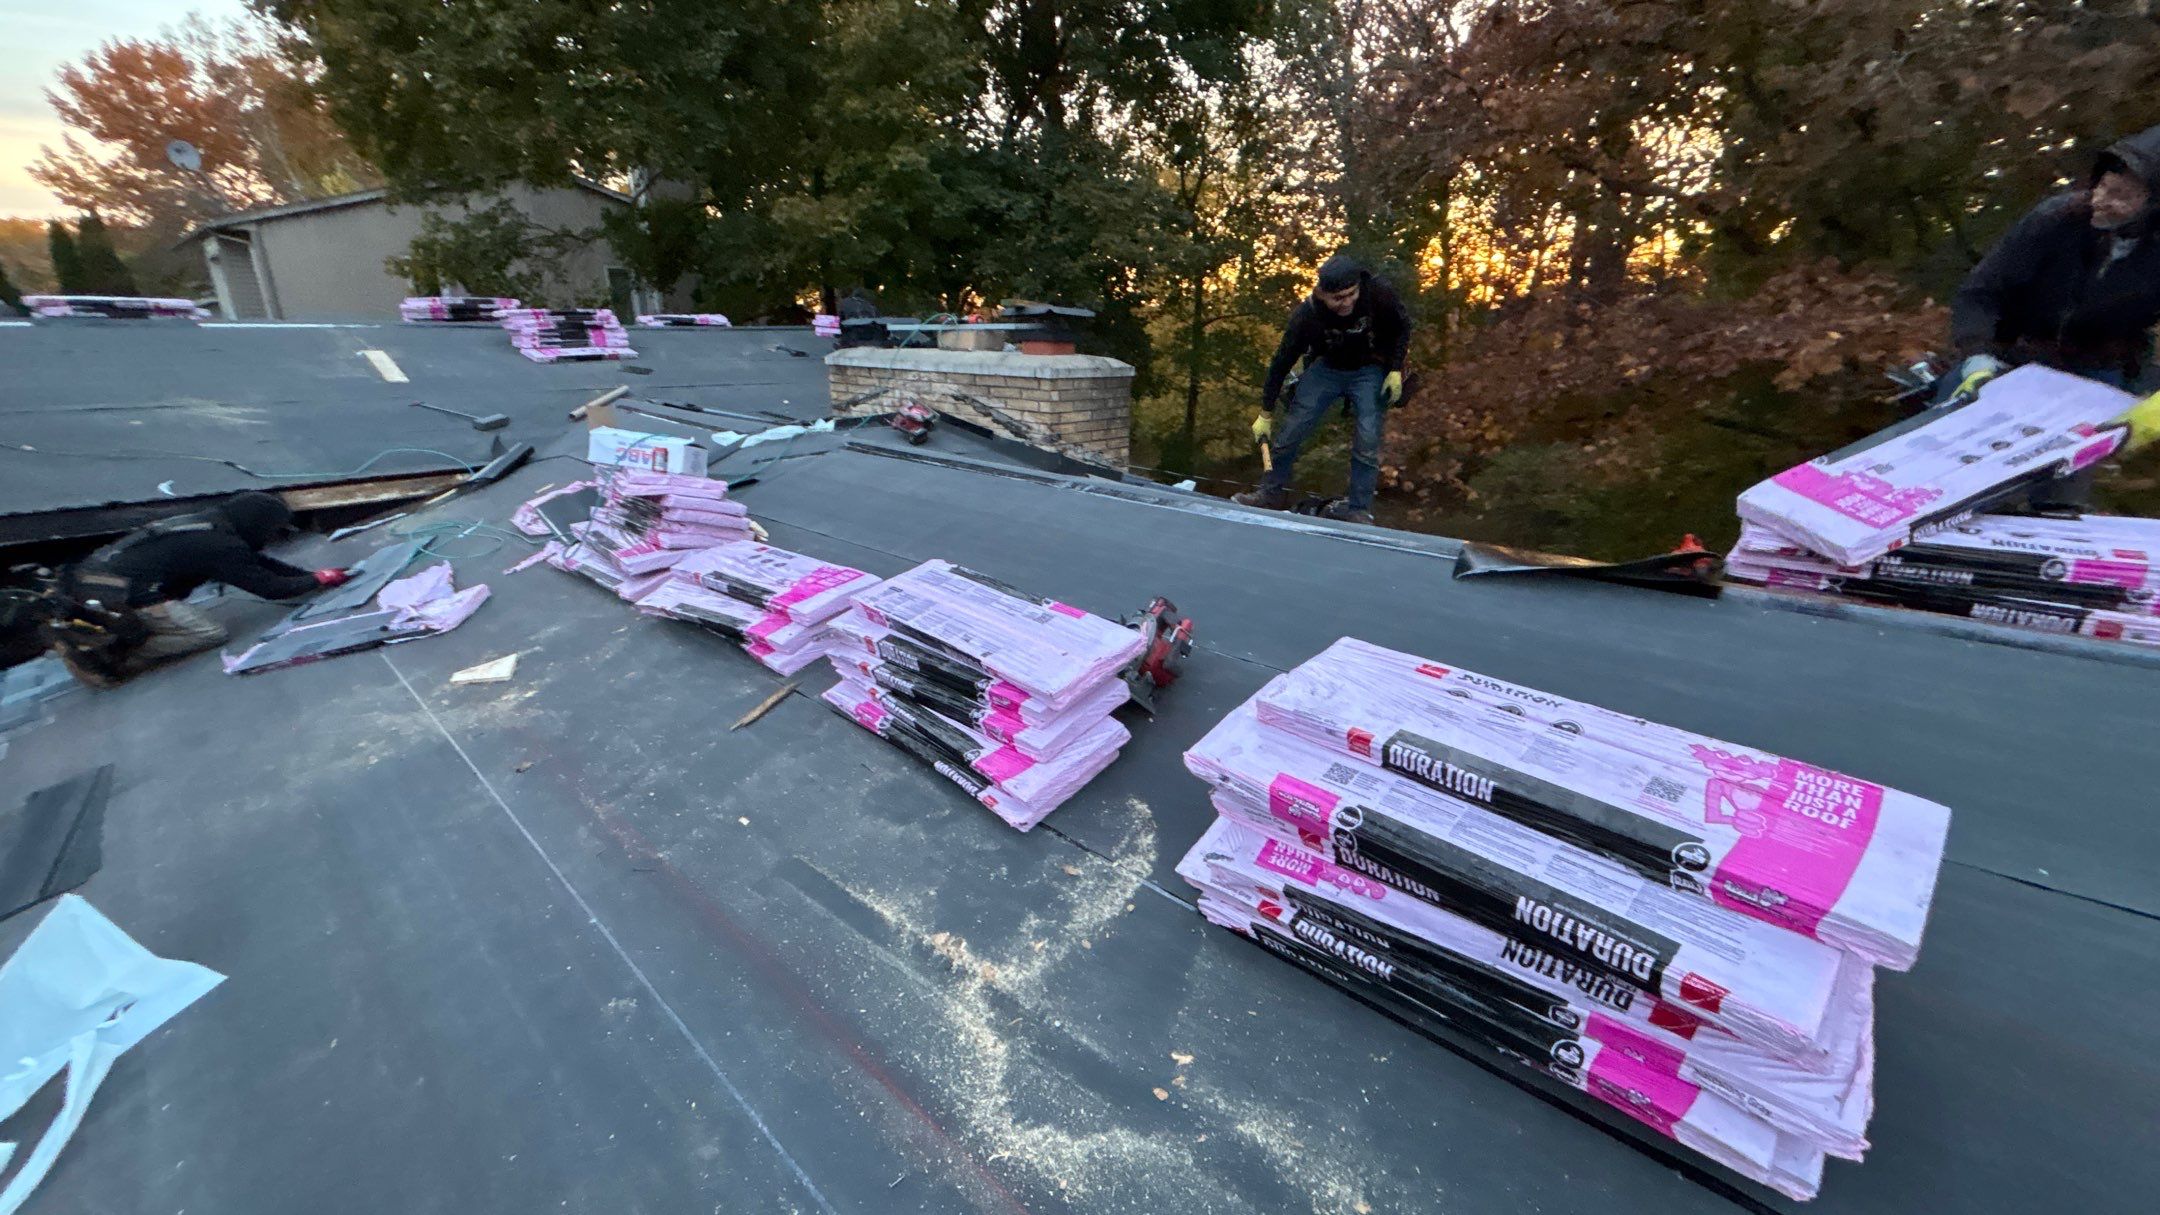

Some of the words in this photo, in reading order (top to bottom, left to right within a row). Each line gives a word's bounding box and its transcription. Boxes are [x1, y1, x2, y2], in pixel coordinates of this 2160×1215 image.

[1388, 743, 1499, 804] DURATION
[1795, 770, 1866, 799] MORE
[1786, 790, 1836, 813] JUST
[1841, 806, 1858, 821] A
[1794, 779, 1863, 810] THAN
[1782, 800, 1856, 830] ROOF
[1267, 853, 1313, 876] MORE
[1294, 919, 1398, 982] DURATION
[1514, 895, 1657, 982] DURATION
[1500, 937, 1636, 1011] DURATION
